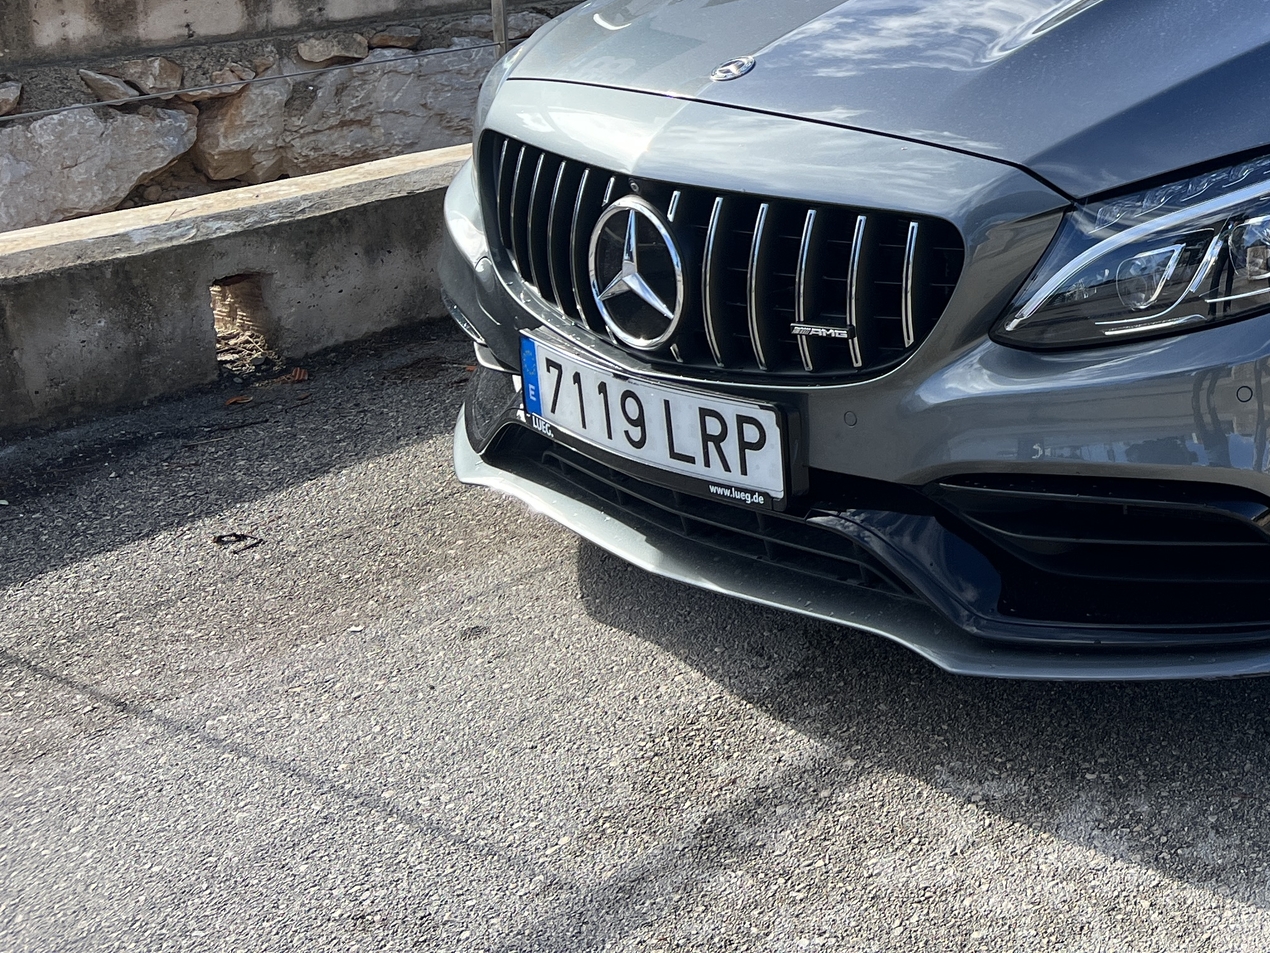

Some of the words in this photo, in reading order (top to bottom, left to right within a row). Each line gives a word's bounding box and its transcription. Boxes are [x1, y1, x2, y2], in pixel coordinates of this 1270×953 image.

[528, 383, 537, 402] E
[545, 357, 647, 450] 7119
[663, 399, 767, 477] LRP
[708, 483, 765, 505] www.lueg.de
